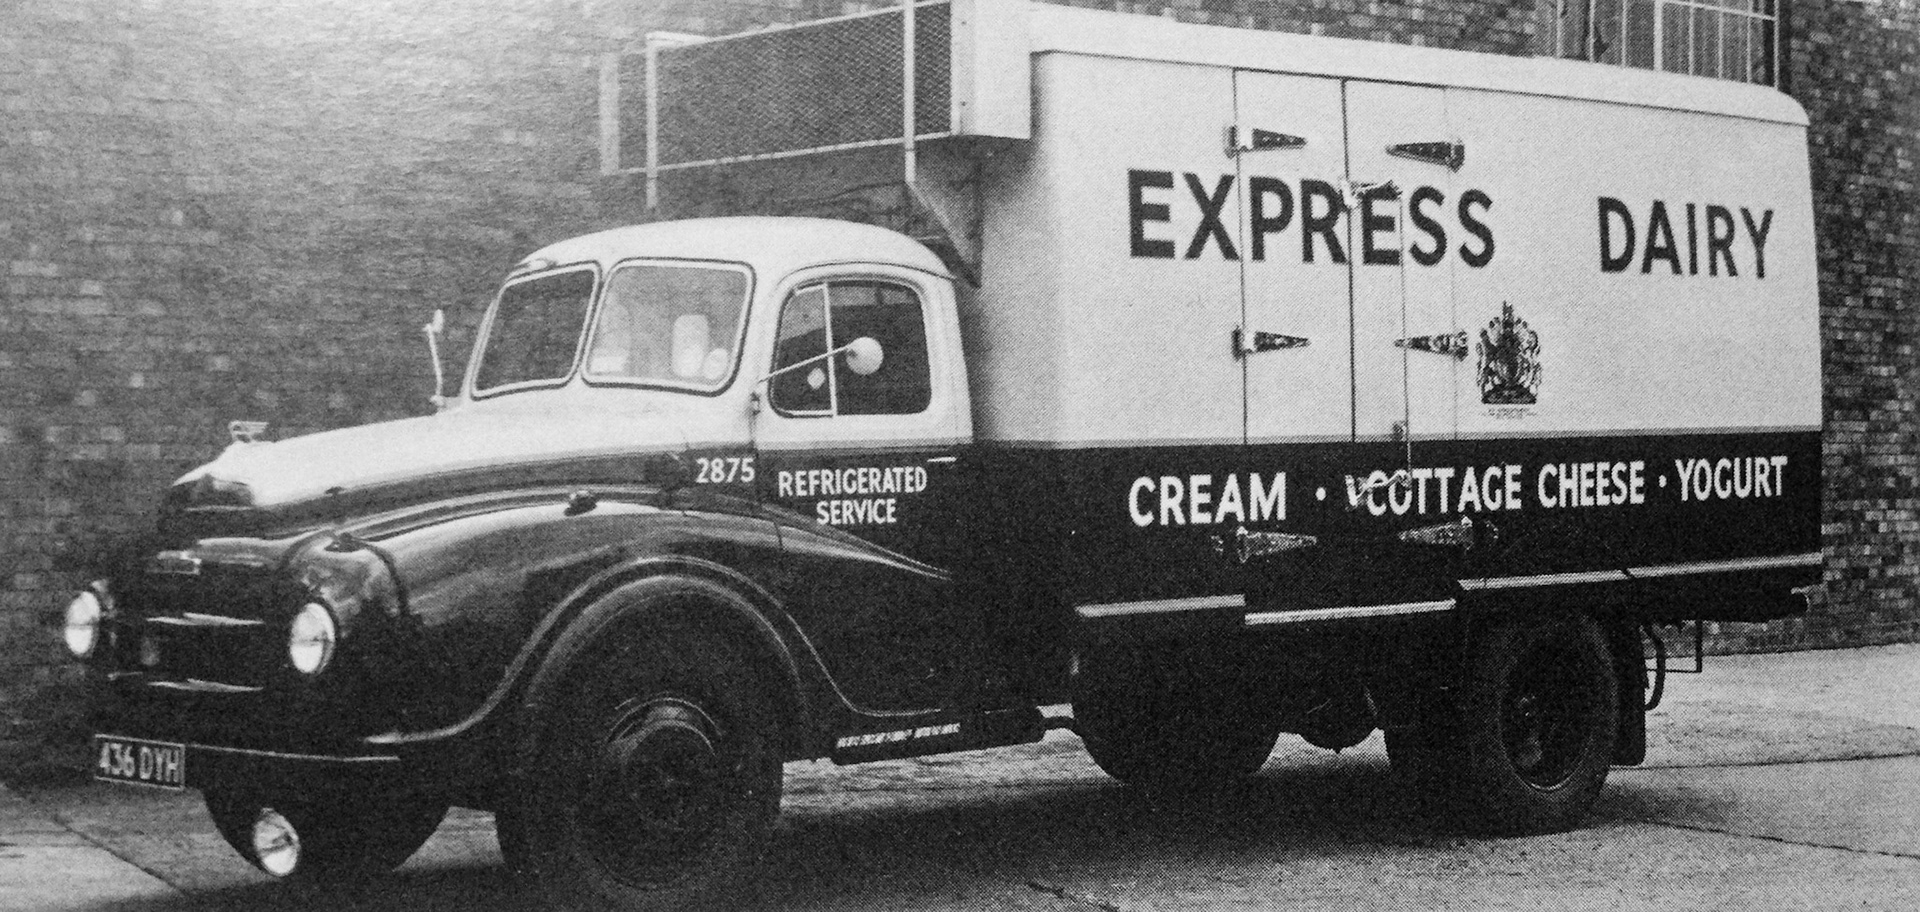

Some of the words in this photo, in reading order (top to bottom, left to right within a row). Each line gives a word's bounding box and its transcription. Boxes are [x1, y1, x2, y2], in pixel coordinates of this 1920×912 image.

[1128, 169, 1496, 267] EXPRESS
[1599, 197, 1774, 278] DAIRY
[695, 457, 756, 483] 2875
[777, 466, 928, 497] REFRIGERATED
[1128, 471, 1287, 526] CREAM
[1365, 465, 1523, 516] COTTAGE
[1538, 460, 1645, 508] CHEESE
[1676, 455, 1788, 502] YOGURT
[816, 498, 897, 525] SERVICE
[99, 742, 136, 777] 436
[139, 746, 180, 782] DYH
